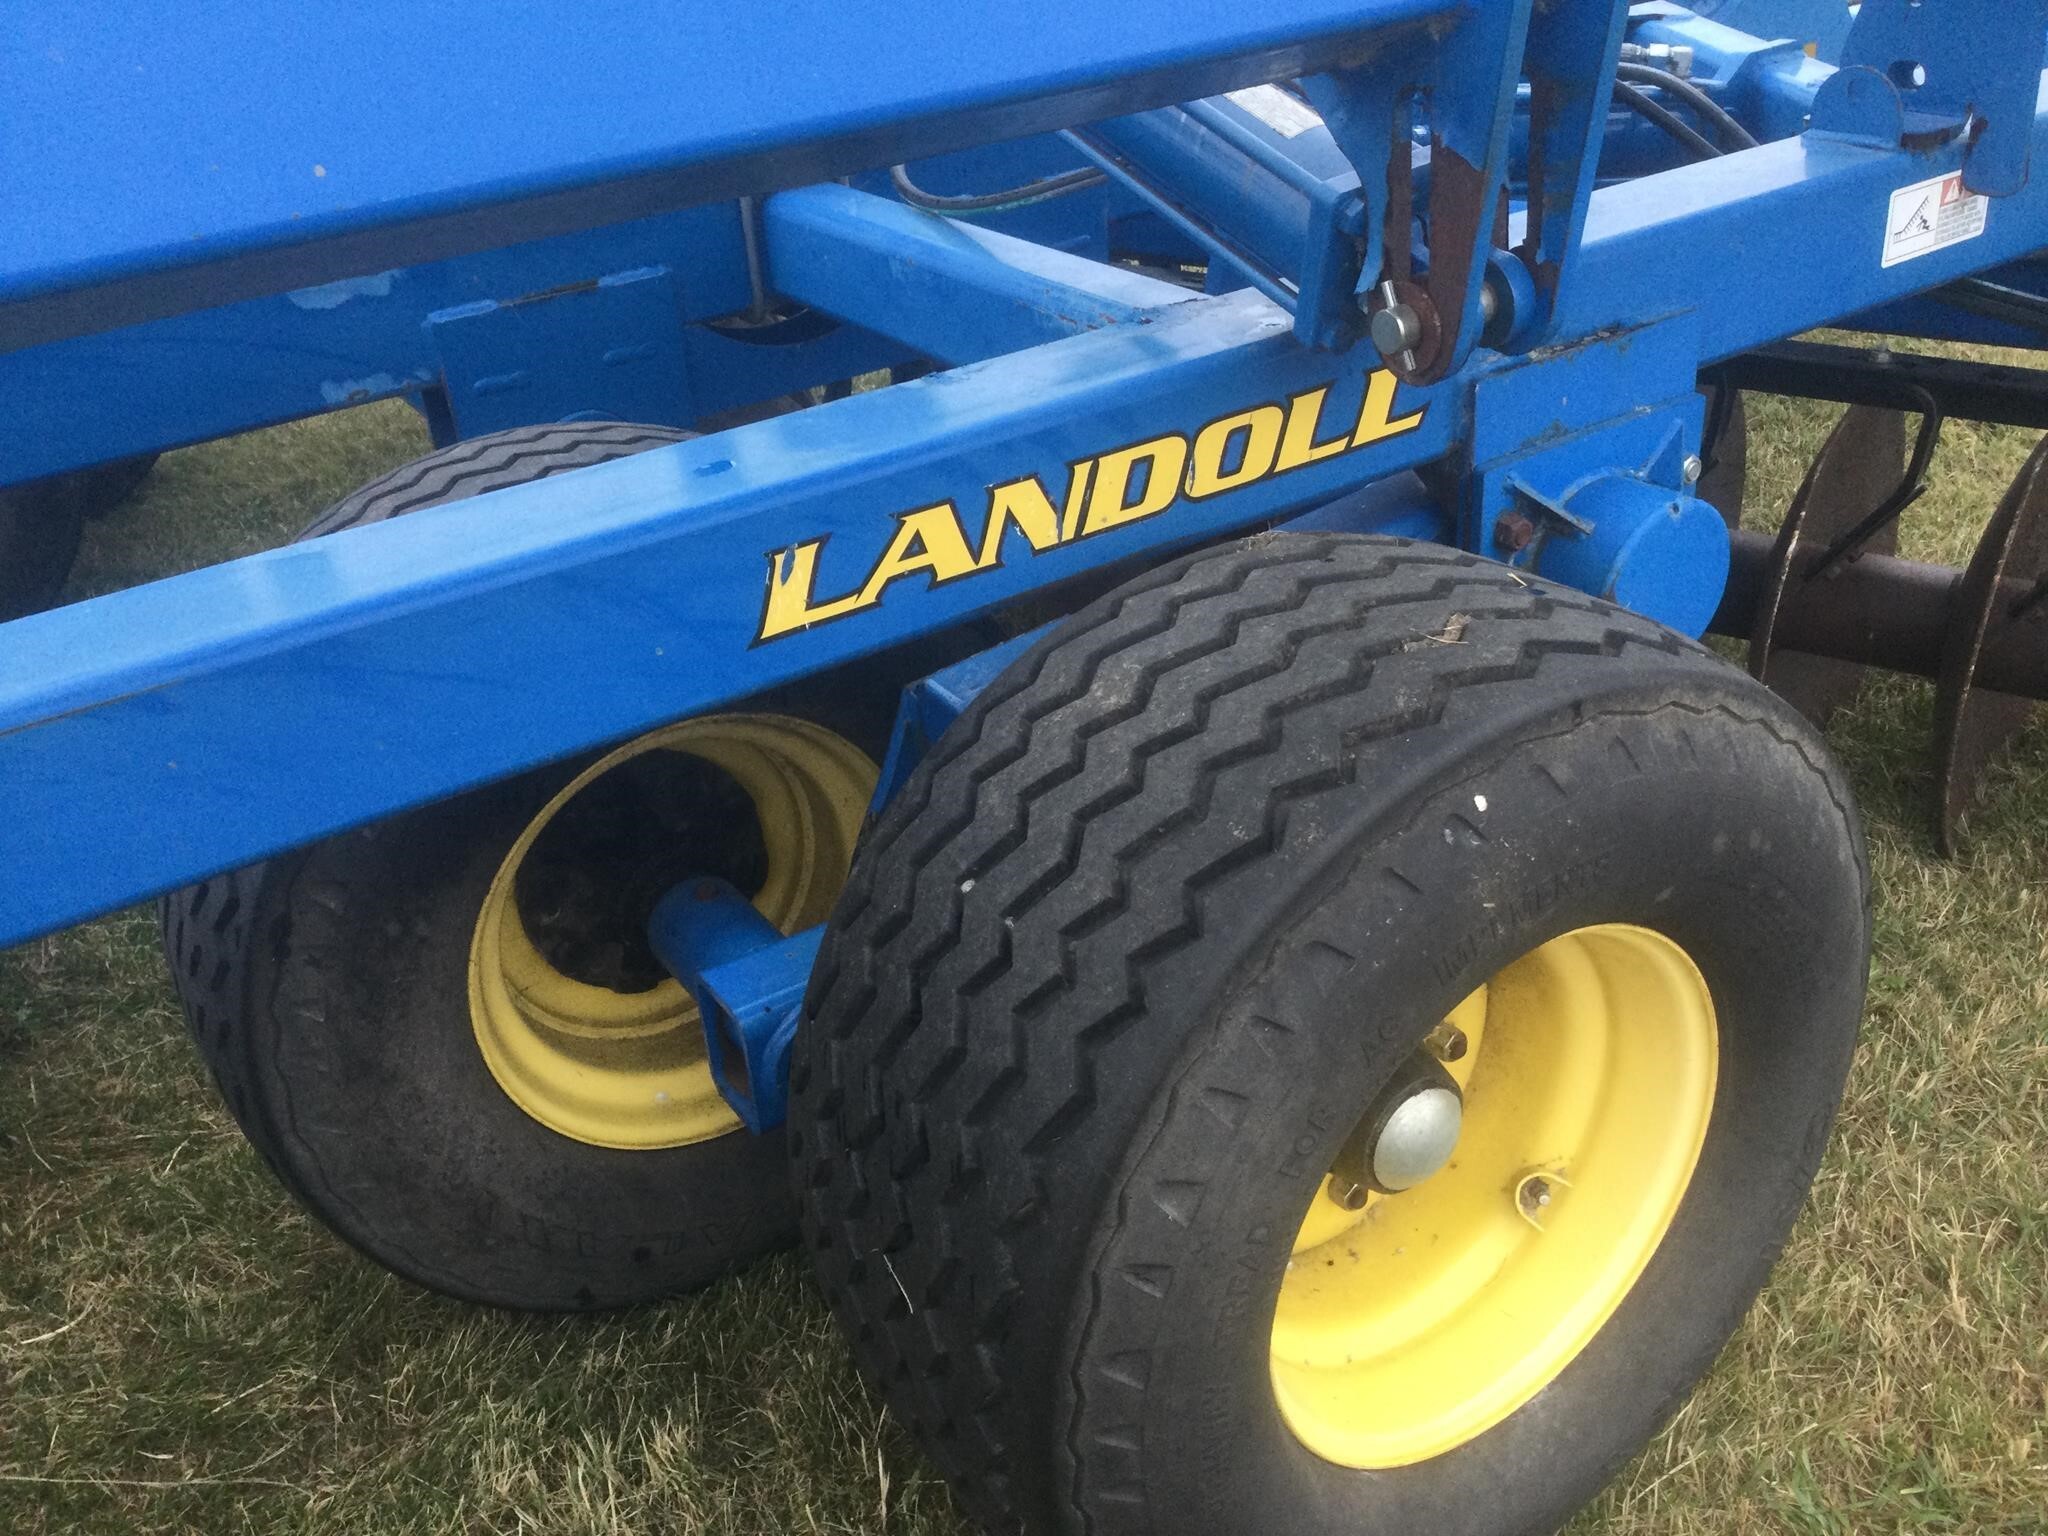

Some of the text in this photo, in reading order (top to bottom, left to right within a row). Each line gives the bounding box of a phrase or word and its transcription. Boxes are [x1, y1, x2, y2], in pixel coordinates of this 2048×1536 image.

[750, 368, 1430, 648] LANDOLL
[1277, 1105, 1337, 1179] FOR
[1355, 1012, 1403, 1068] AG
